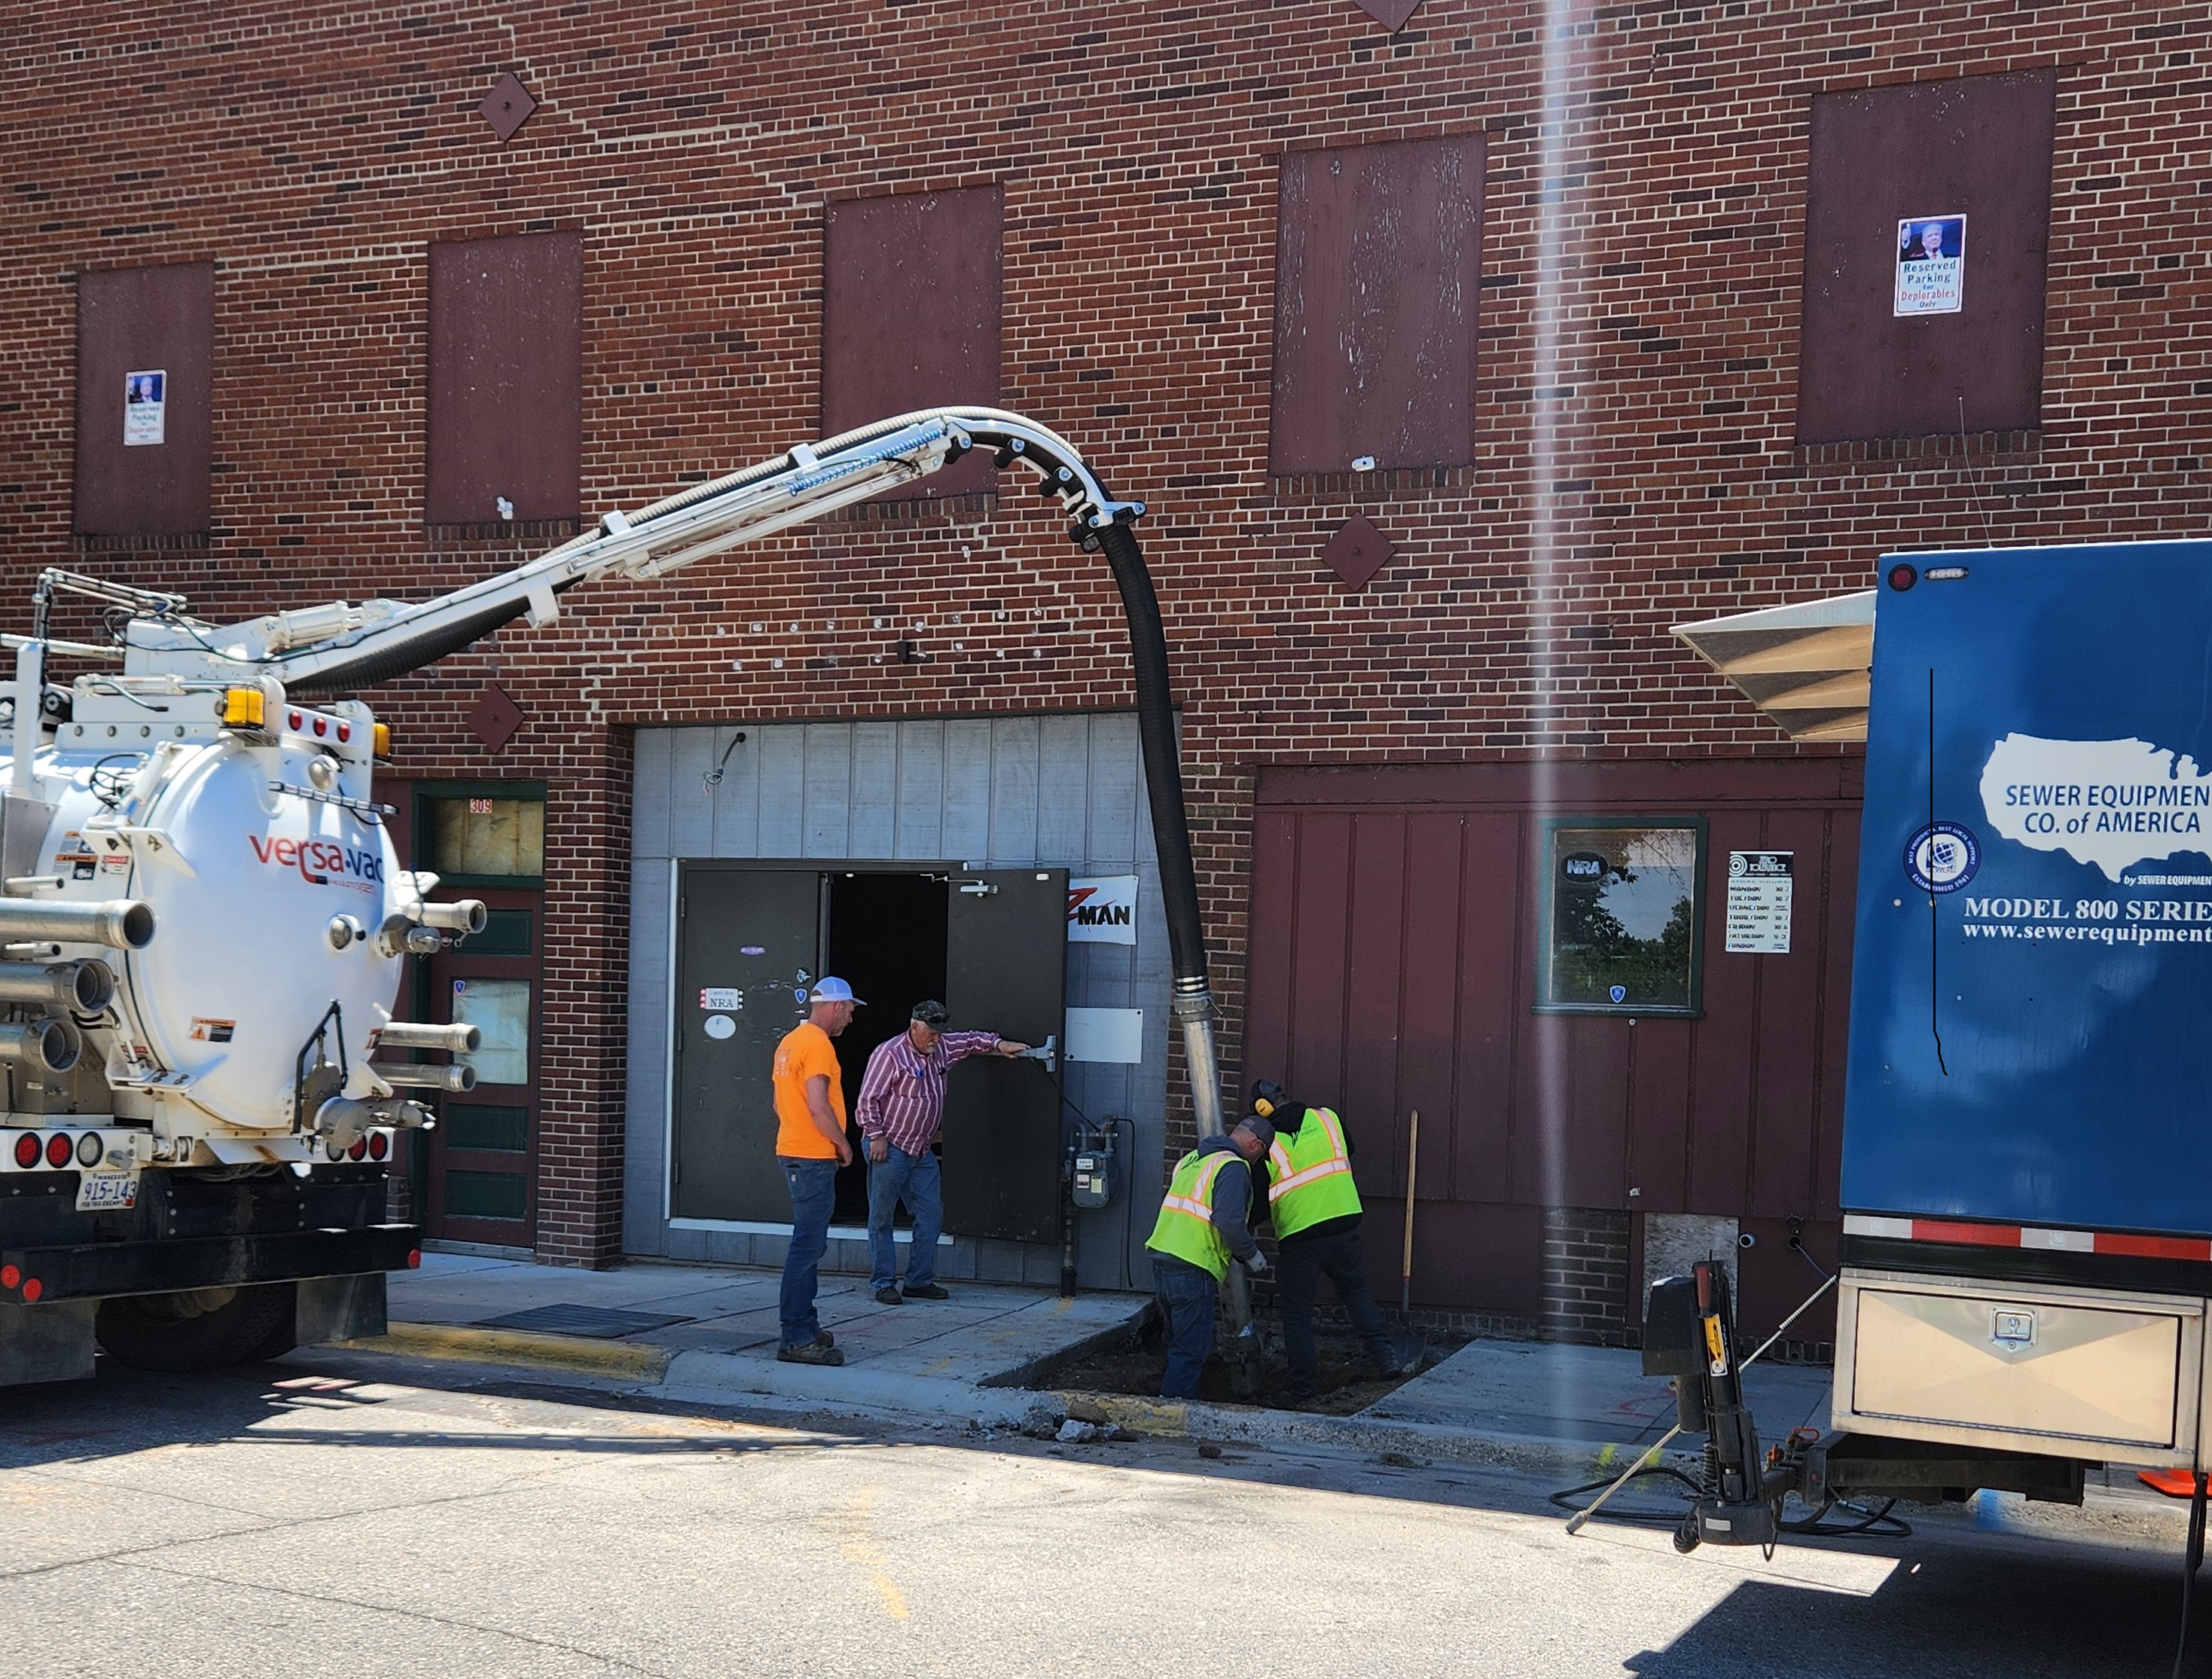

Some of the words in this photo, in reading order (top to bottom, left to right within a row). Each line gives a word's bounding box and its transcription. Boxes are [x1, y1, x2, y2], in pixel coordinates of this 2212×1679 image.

[1904, 259, 1956, 273] Reserved
[1908, 273, 1951, 284] Parking
[1902, 289, 1955, 301] Deplorables
[2006, 785, 2080, 806] SEWER
[2088, 785, 2212, 808] EQUIPMEN
[471, 799, 491, 812] 309
[2024, 812, 2060, 833] CO.
[2066, 812, 2091, 834] of
[2095, 811, 2201, 833] AMERICA
[1567, 860, 1600, 875] NRA
[2124, 875, 2137, 887] by
[2137, 875, 2167, 885] SEWER
[1963, 897, 2070, 918] MODEL
[2075, 899, 2118, 919] 800
[2125, 900, 2212, 921] SERIE
[1963, 923, 2212, 947] www.sewerequipment
[709, 998, 734, 1008] NRA
[84, 1181, 137, 1200] 915-143
